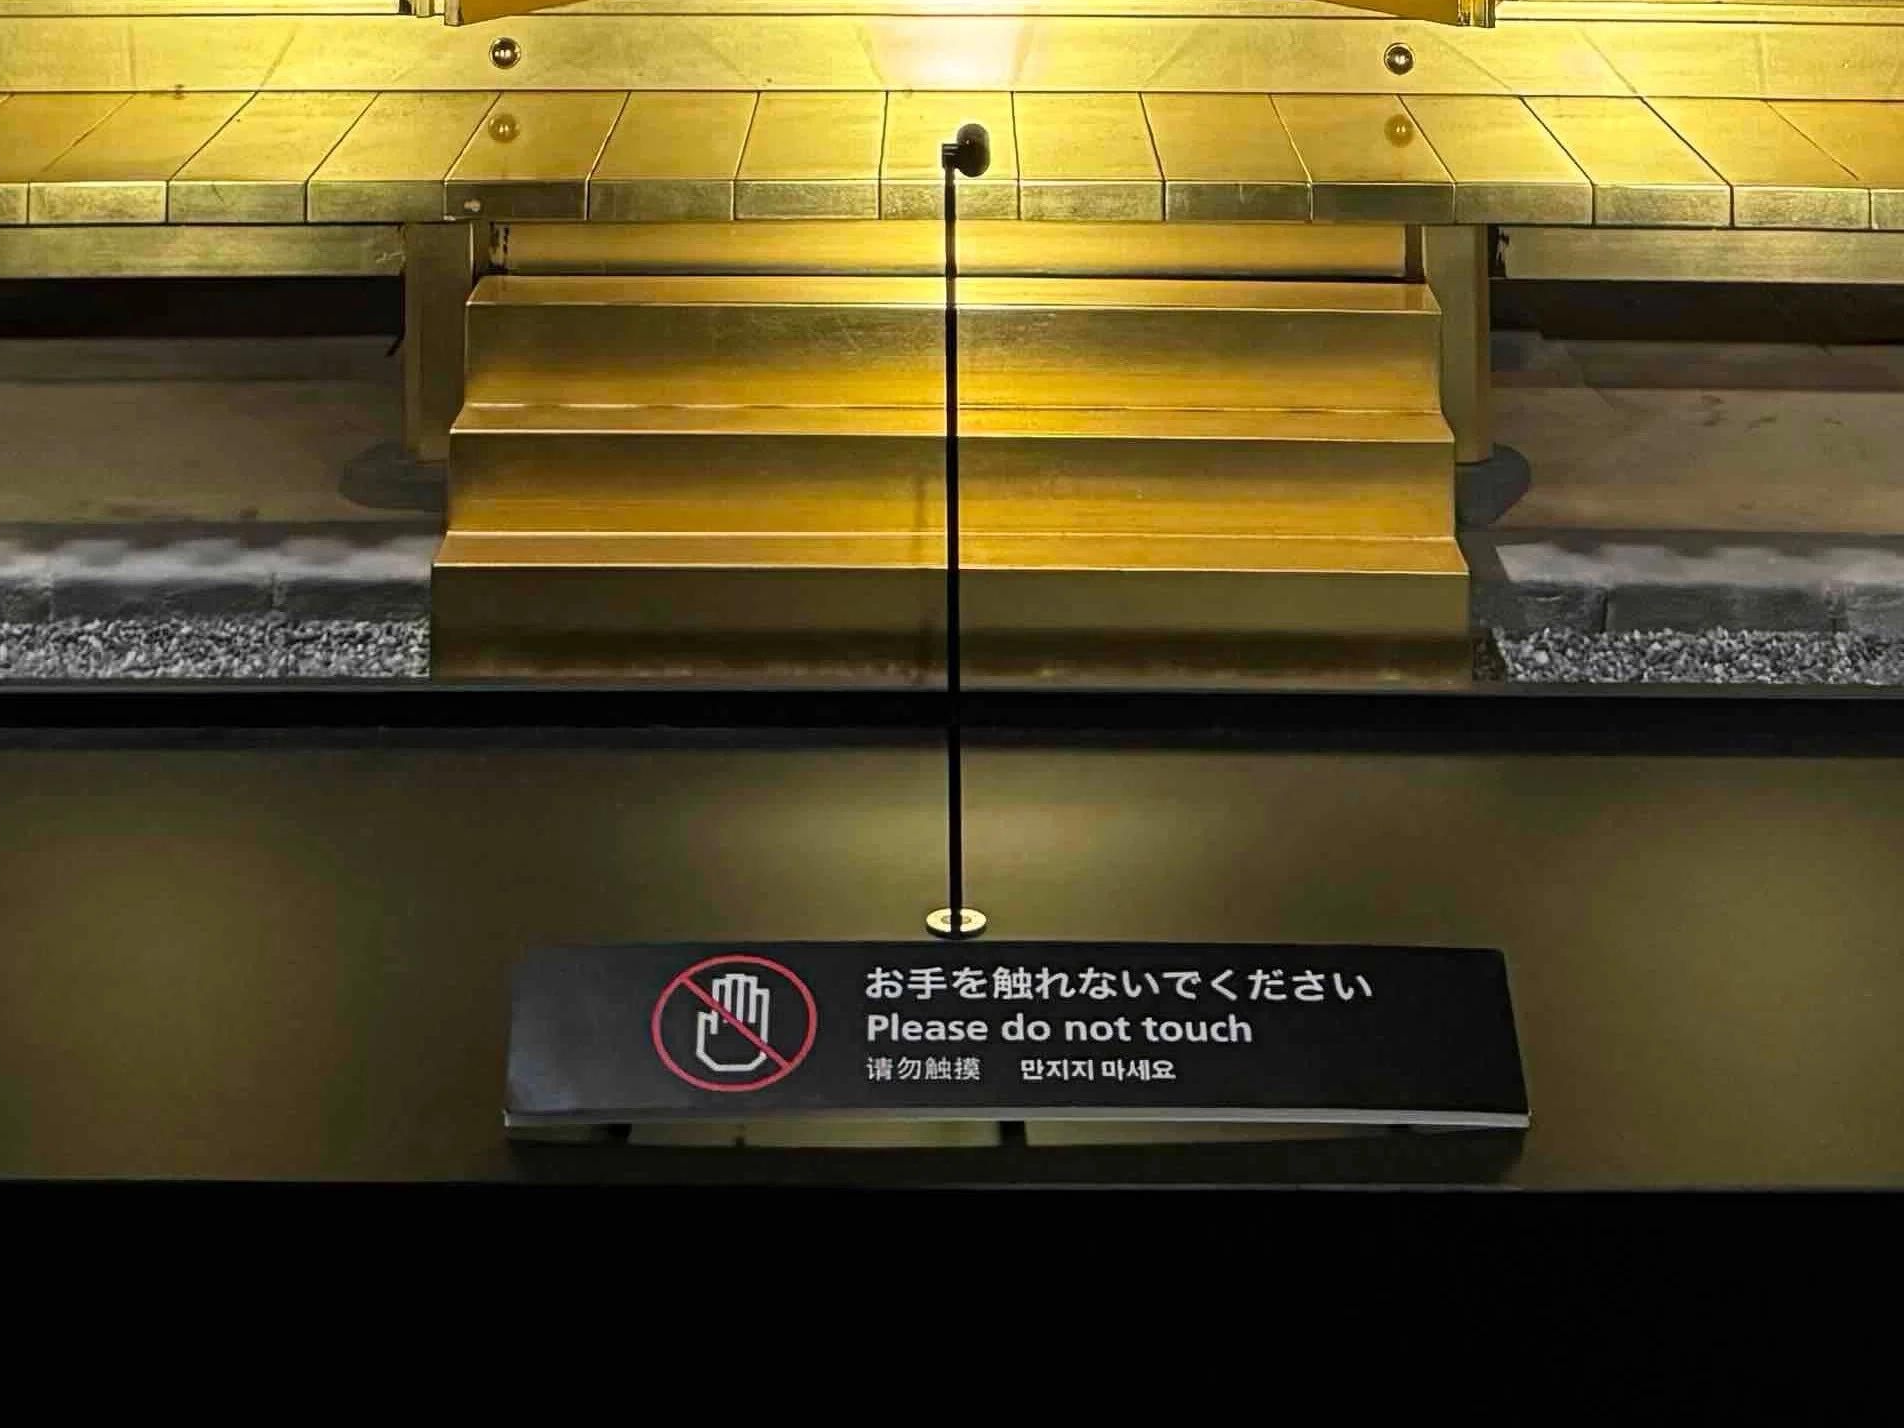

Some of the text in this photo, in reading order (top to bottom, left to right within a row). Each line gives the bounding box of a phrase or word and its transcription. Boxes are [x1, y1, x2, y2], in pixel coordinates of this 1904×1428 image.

[865, 966, 1372, 1001] お手を触れないでください
[867, 1013, 1252, 1042] Please do not touch
[866, 1056, 980, 1081] 请勿触摸
[1020, 1058, 1176, 1080] 만지지 마세요
